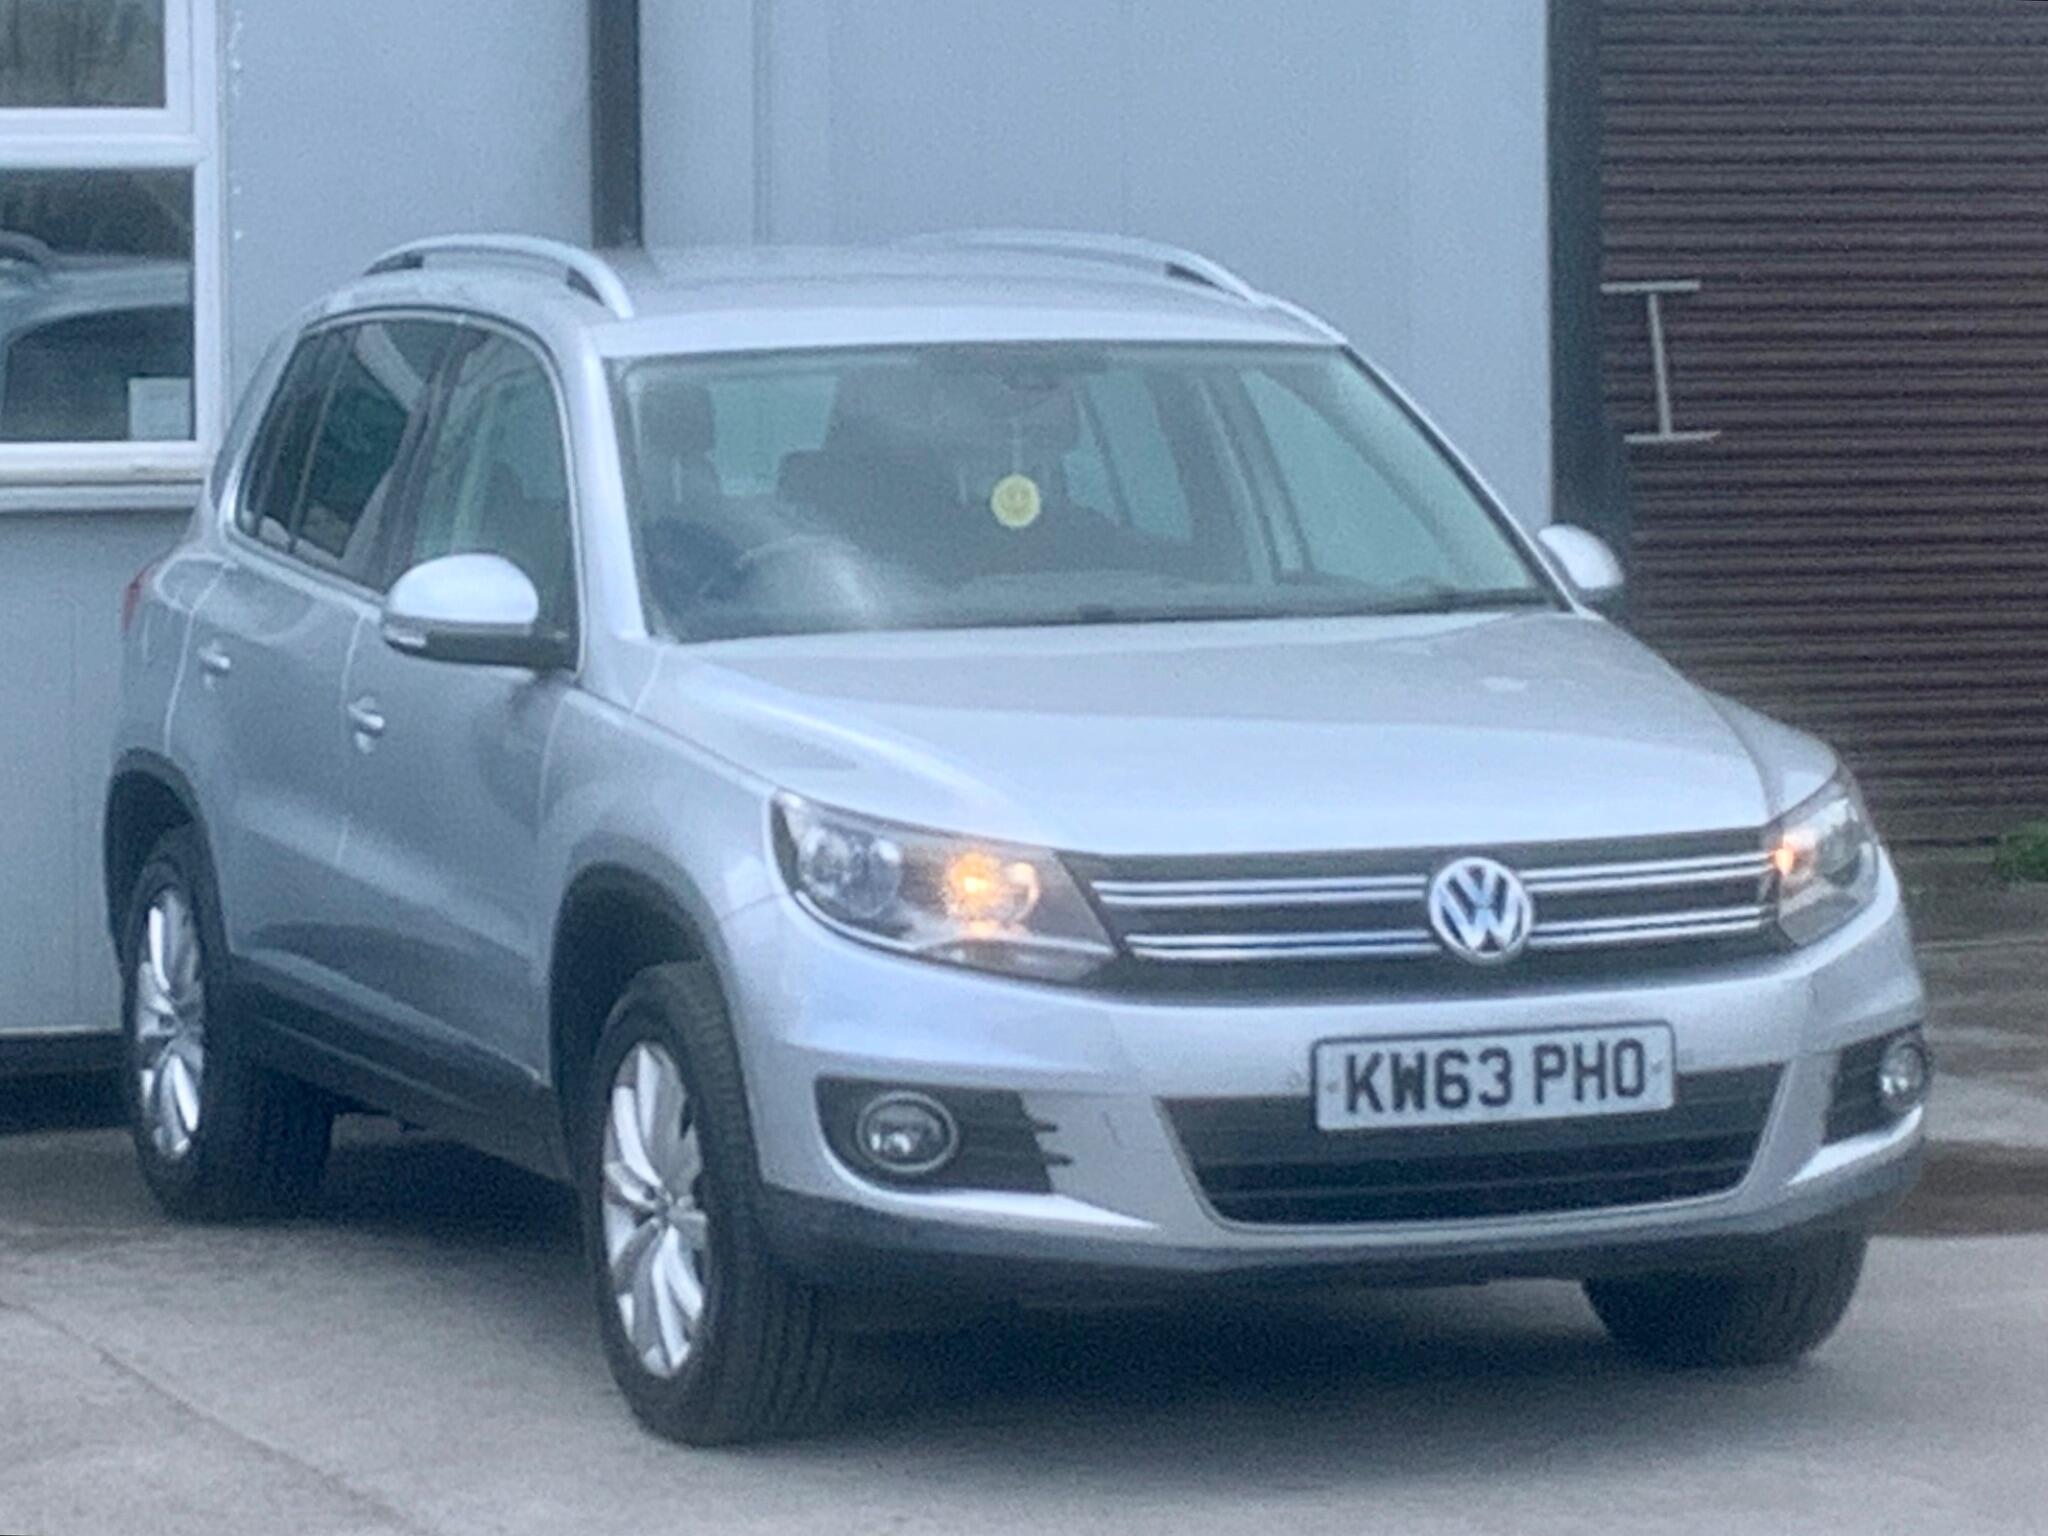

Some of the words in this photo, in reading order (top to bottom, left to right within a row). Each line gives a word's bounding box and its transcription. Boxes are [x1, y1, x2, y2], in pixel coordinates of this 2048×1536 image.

[1433, 859, 1527, 955] VW
[1345, 1046, 1513, 1115] KW63
[1533, 1037, 1646, 1105] PHO
